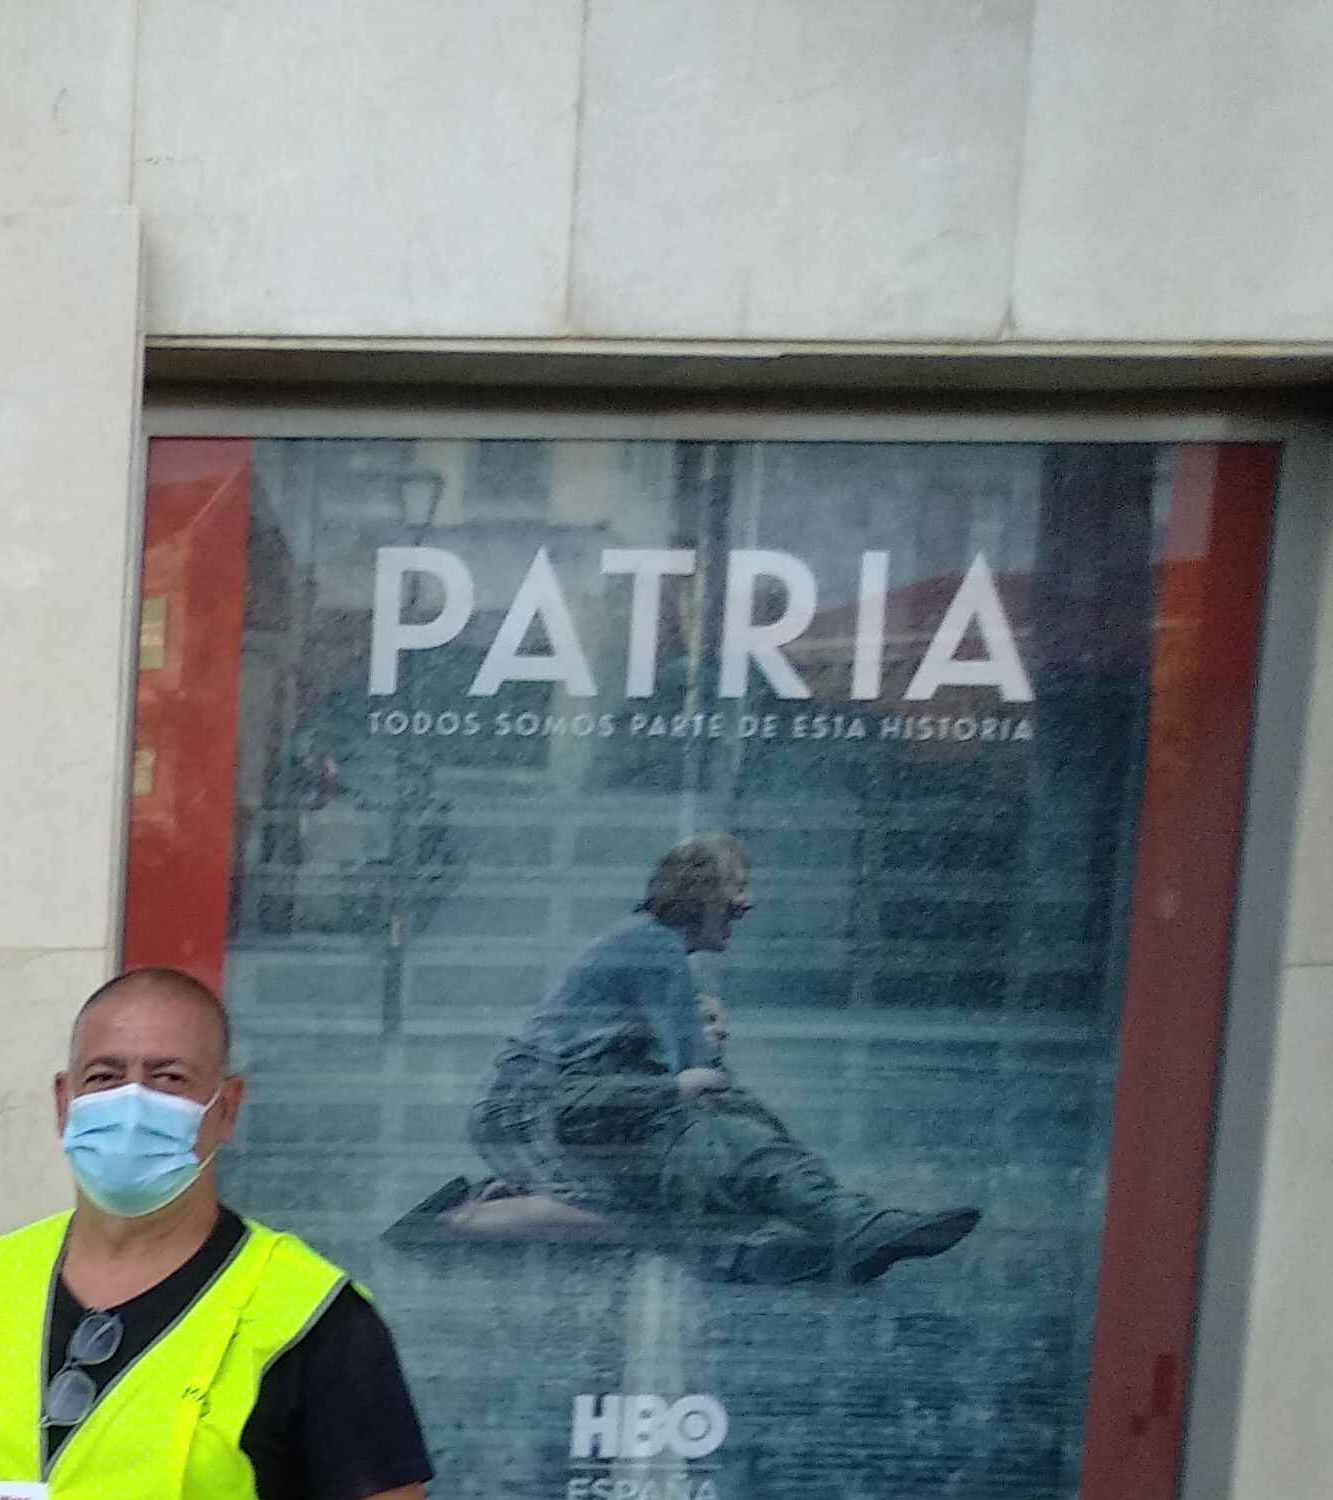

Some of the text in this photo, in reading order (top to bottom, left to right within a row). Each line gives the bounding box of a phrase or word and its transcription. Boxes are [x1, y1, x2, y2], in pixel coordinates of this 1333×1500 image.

[368, 546, 1036, 703] PATRIA
[370, 711, 1035, 742] TODOS SOMOS PARTE DE ESTA HISTORIA
[570, 1393, 729, 1459] HBO
